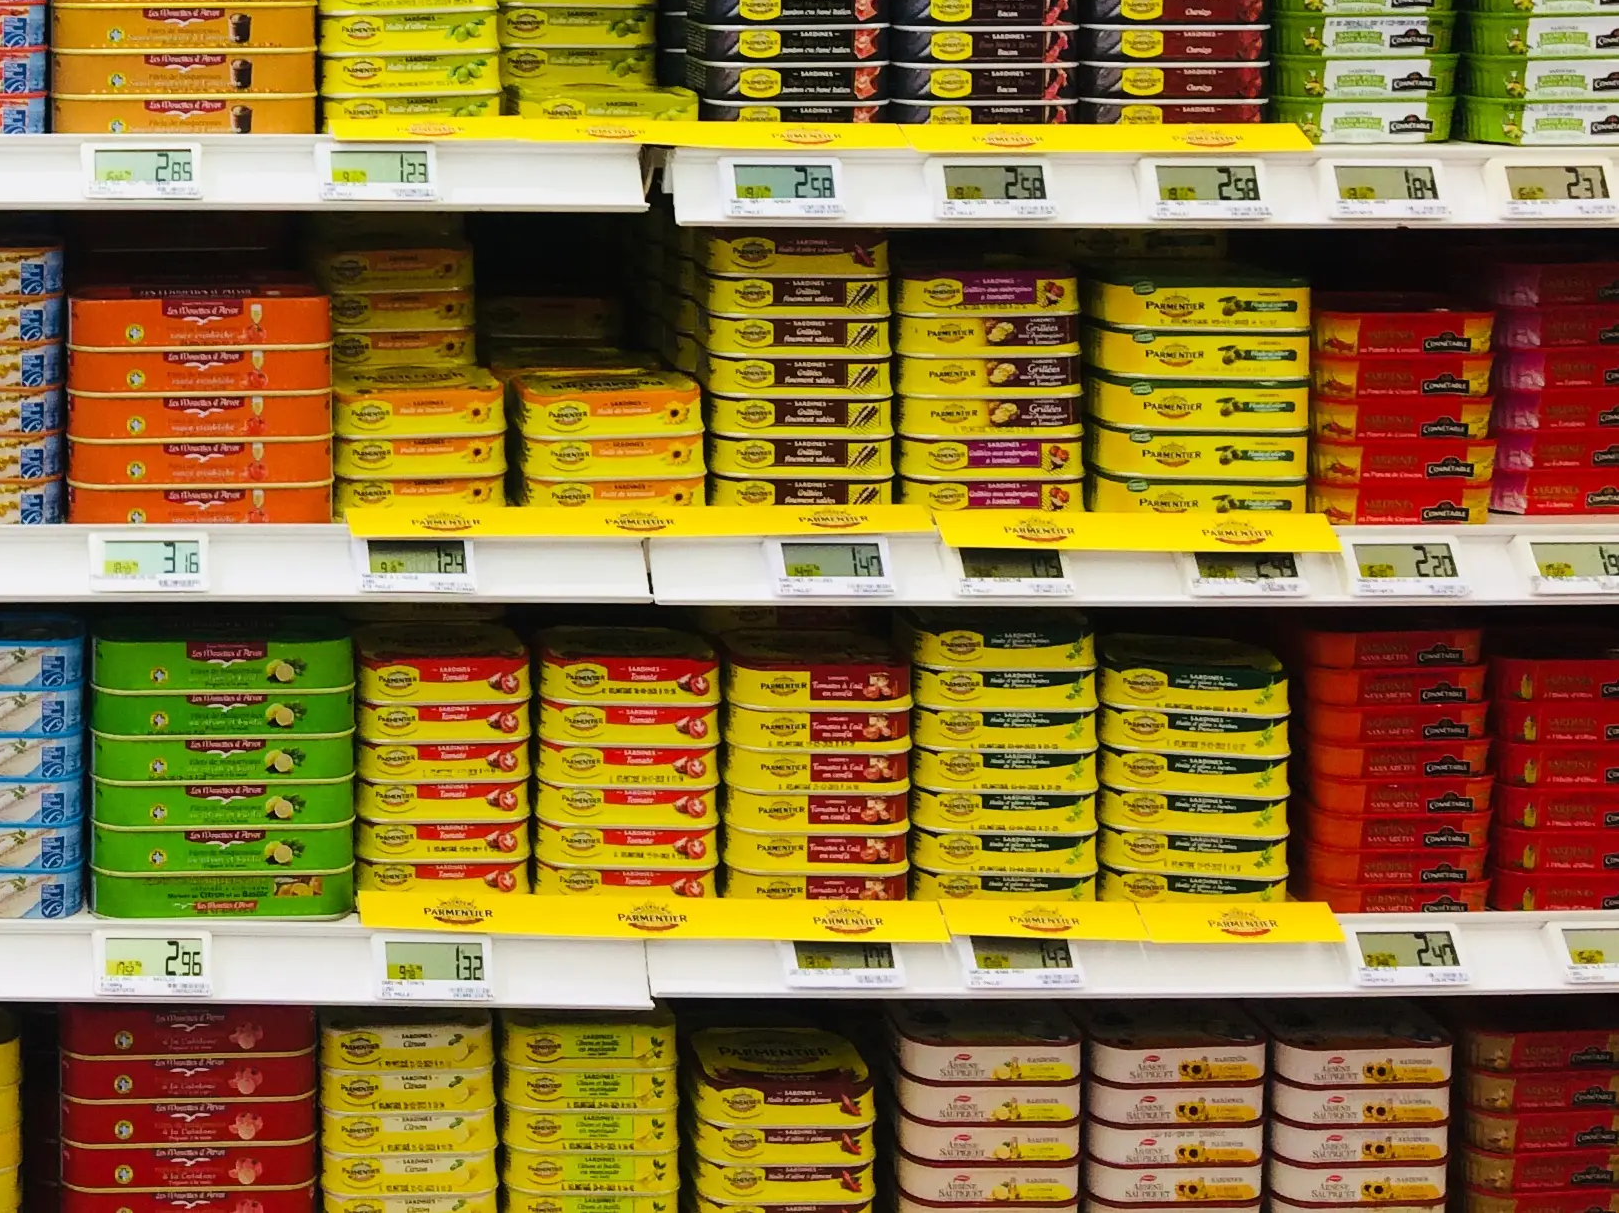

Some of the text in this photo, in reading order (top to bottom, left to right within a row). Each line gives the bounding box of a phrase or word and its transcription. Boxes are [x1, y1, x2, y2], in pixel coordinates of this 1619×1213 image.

[342, 27, 381, 35] PARMENTIER
[1145, 301, 1205, 312] PARMENTIER
[412, 518, 480, 527] PARMENTIER
[1004, 525, 1075, 536] PARMENTIER
[761, 682, 807, 691] PARMENTIER
[424, 909, 492, 919] PARMENTIER
[618, 914, 687, 924] PARMENTIER
[813, 916, 883, 927] PARMENTIER
[717, 1046, 832, 1059] PARMENTIER
